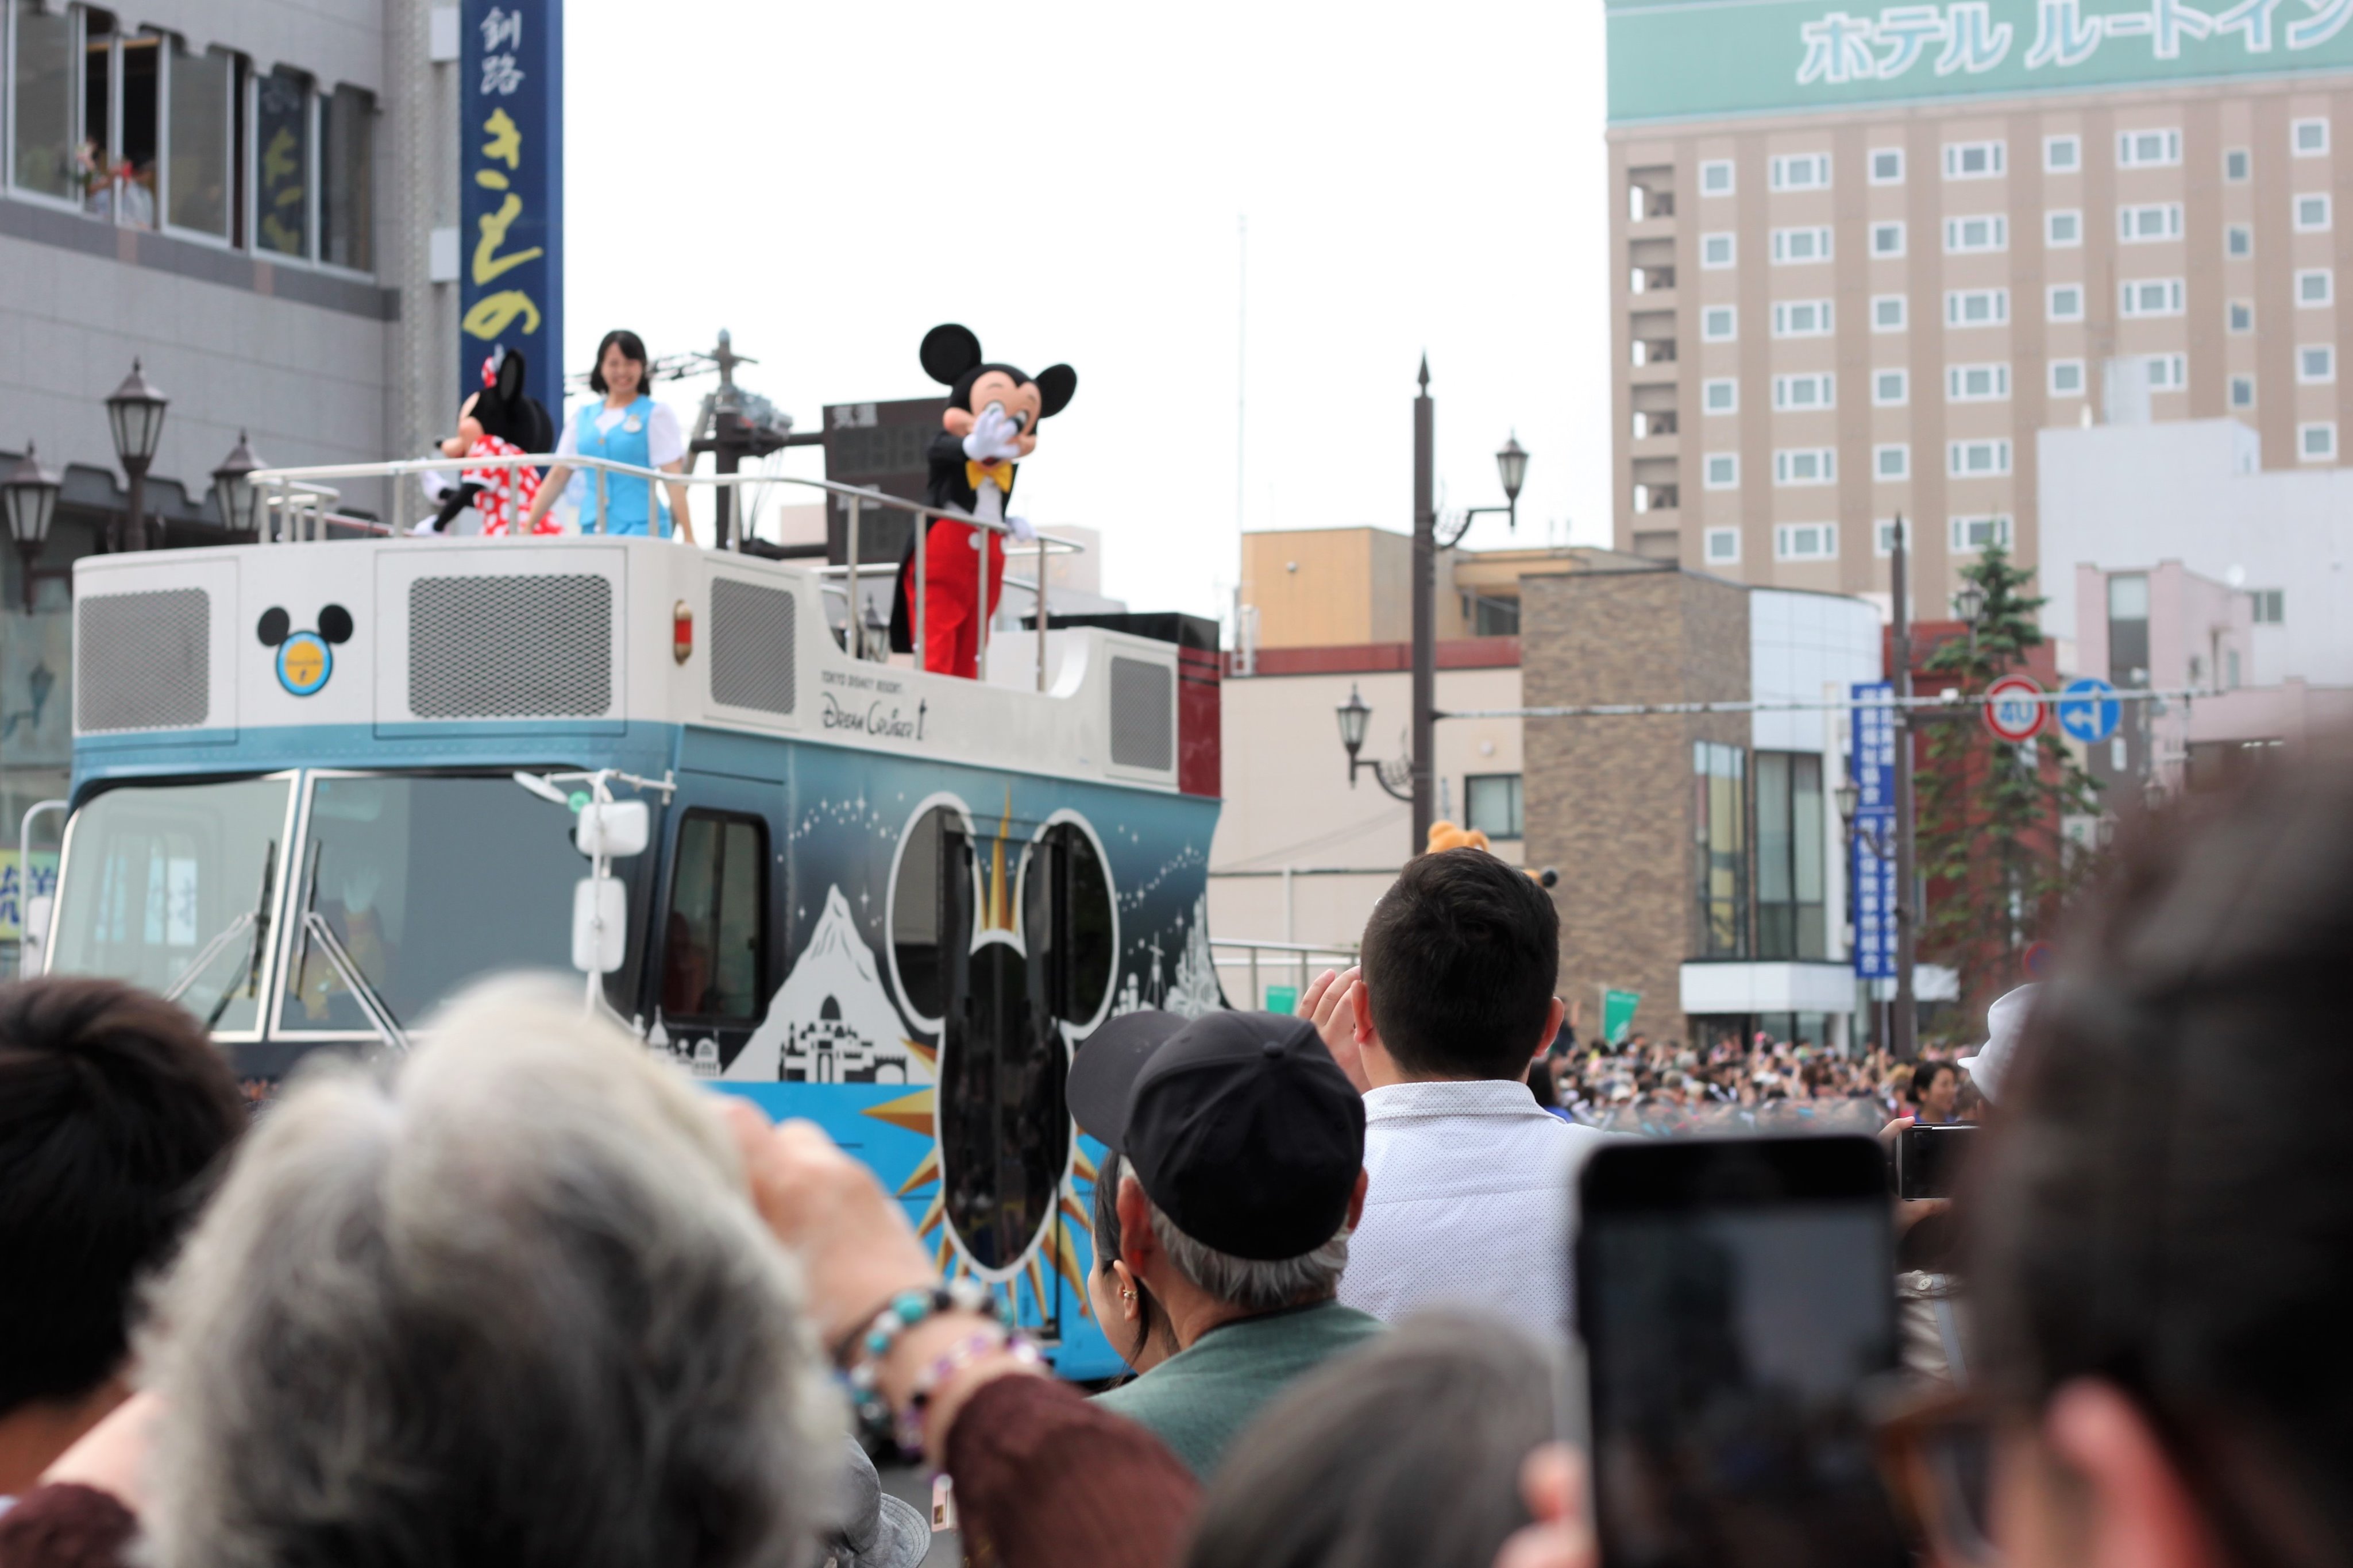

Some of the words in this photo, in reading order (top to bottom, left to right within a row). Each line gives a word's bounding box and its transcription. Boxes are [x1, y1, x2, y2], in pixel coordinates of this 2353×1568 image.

[480, 6, 525, 95] 釧路
[1796, 2, 2013, 84] ホテル
